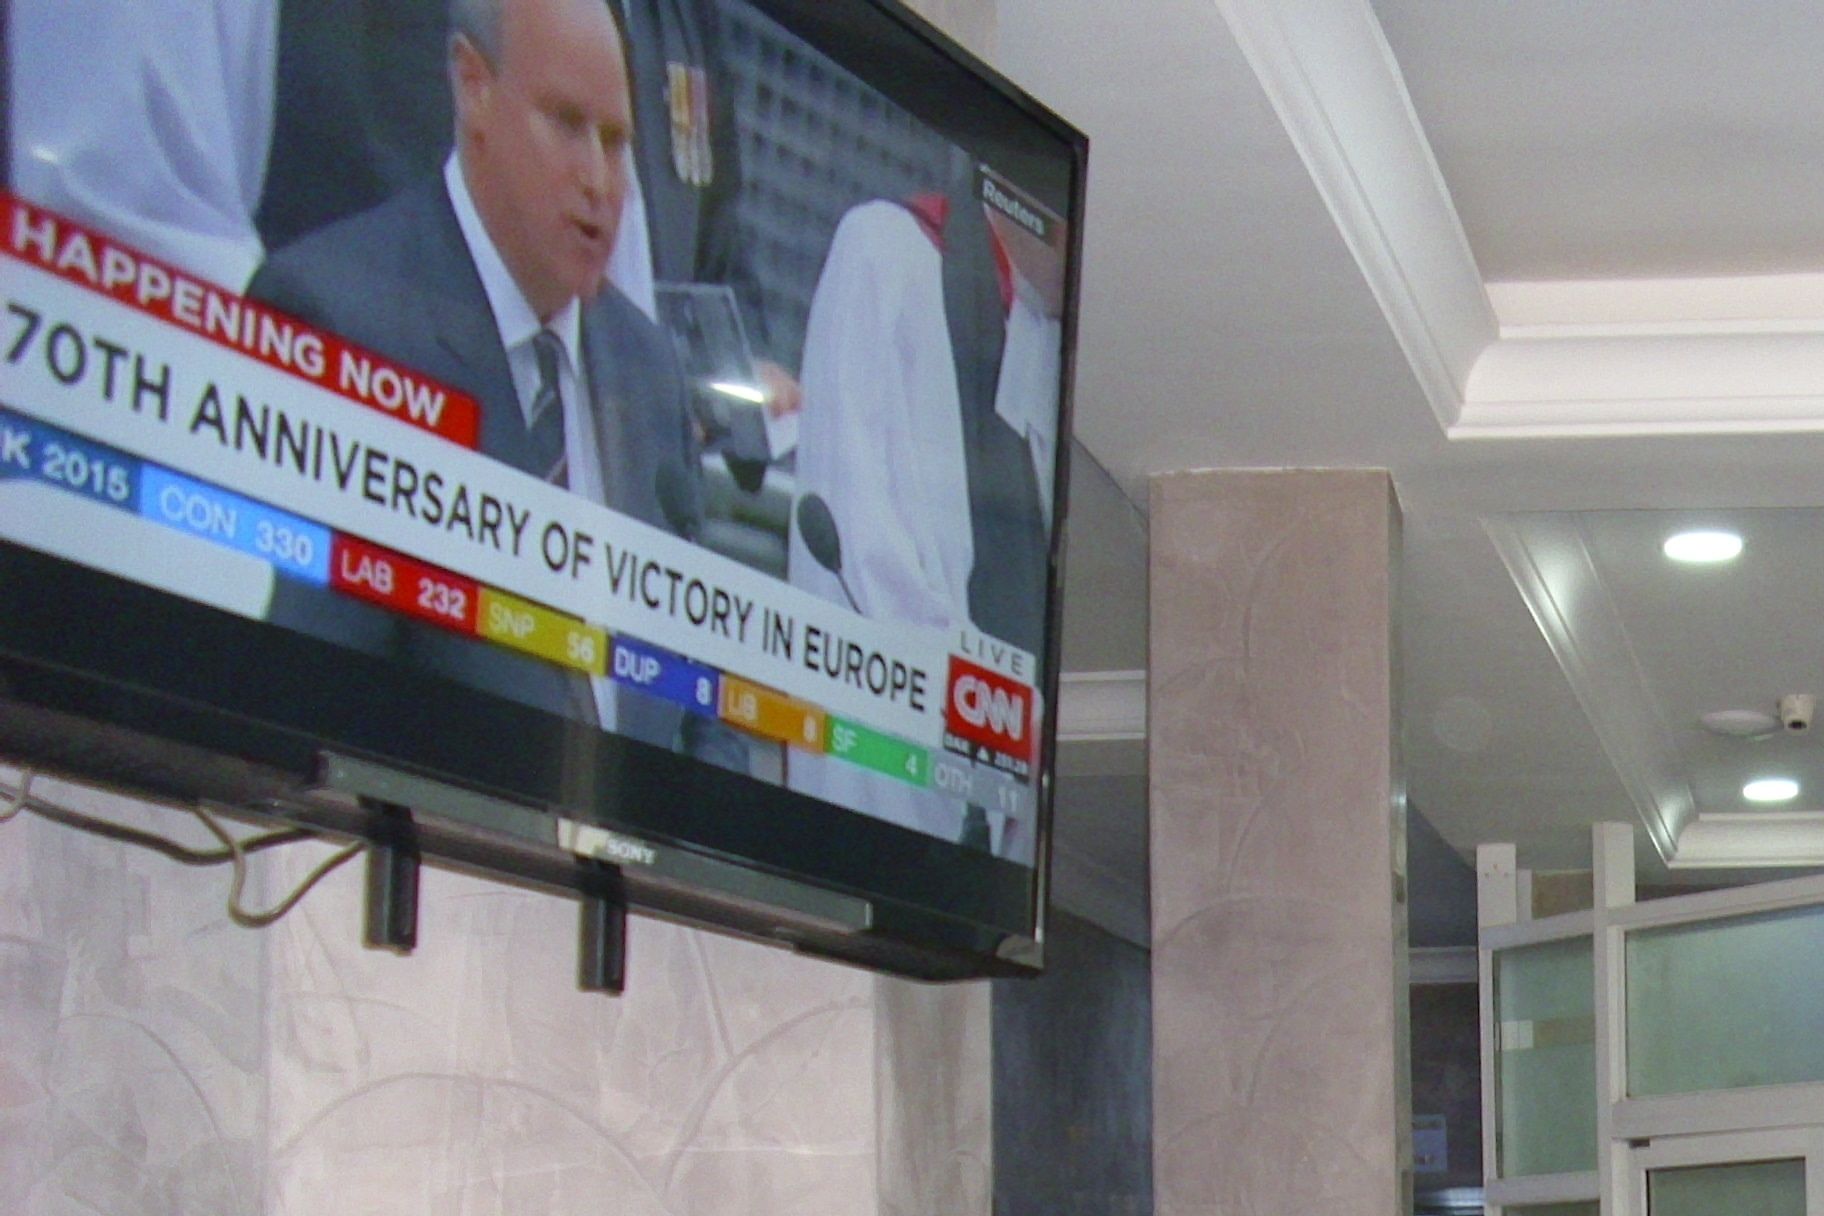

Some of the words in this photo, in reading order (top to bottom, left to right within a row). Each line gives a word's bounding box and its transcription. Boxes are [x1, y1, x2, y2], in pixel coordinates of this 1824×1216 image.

[982, 178, 1045, 236] Reuters
[11, 205, 326, 378] HAPPENING
[339, 350, 446, 427] NOW
[0, 427, 32, 469] K
[42, 442, 130, 500] 2015
[7, 303, 170, 422] 70TH
[188, 380, 531, 556] ANNIVERSARY
[541, 520, 595, 580] OF
[605, 542, 754, 643] VICTORY
[762, 607, 794, 661] IN
[804, 624, 928, 713] EUROPE
[160, 484, 237, 538] CON
[255, 520, 313, 567] 330
[340, 548, 394, 595] LAB
[417, 577, 466, 620] 232
[487, 605, 536, 639] SNP
[566, 631, 595, 662] 56
[960, 629, 1025, 677] LIVE
[613, 646, 661, 685] DUP
[953, 673, 1025, 741] CNN
[832, 721, 858, 753] SF
[904, 753, 918, 777] 4
[933, 762, 974, 795] OTH
[607, 838, 656, 865] SONY
